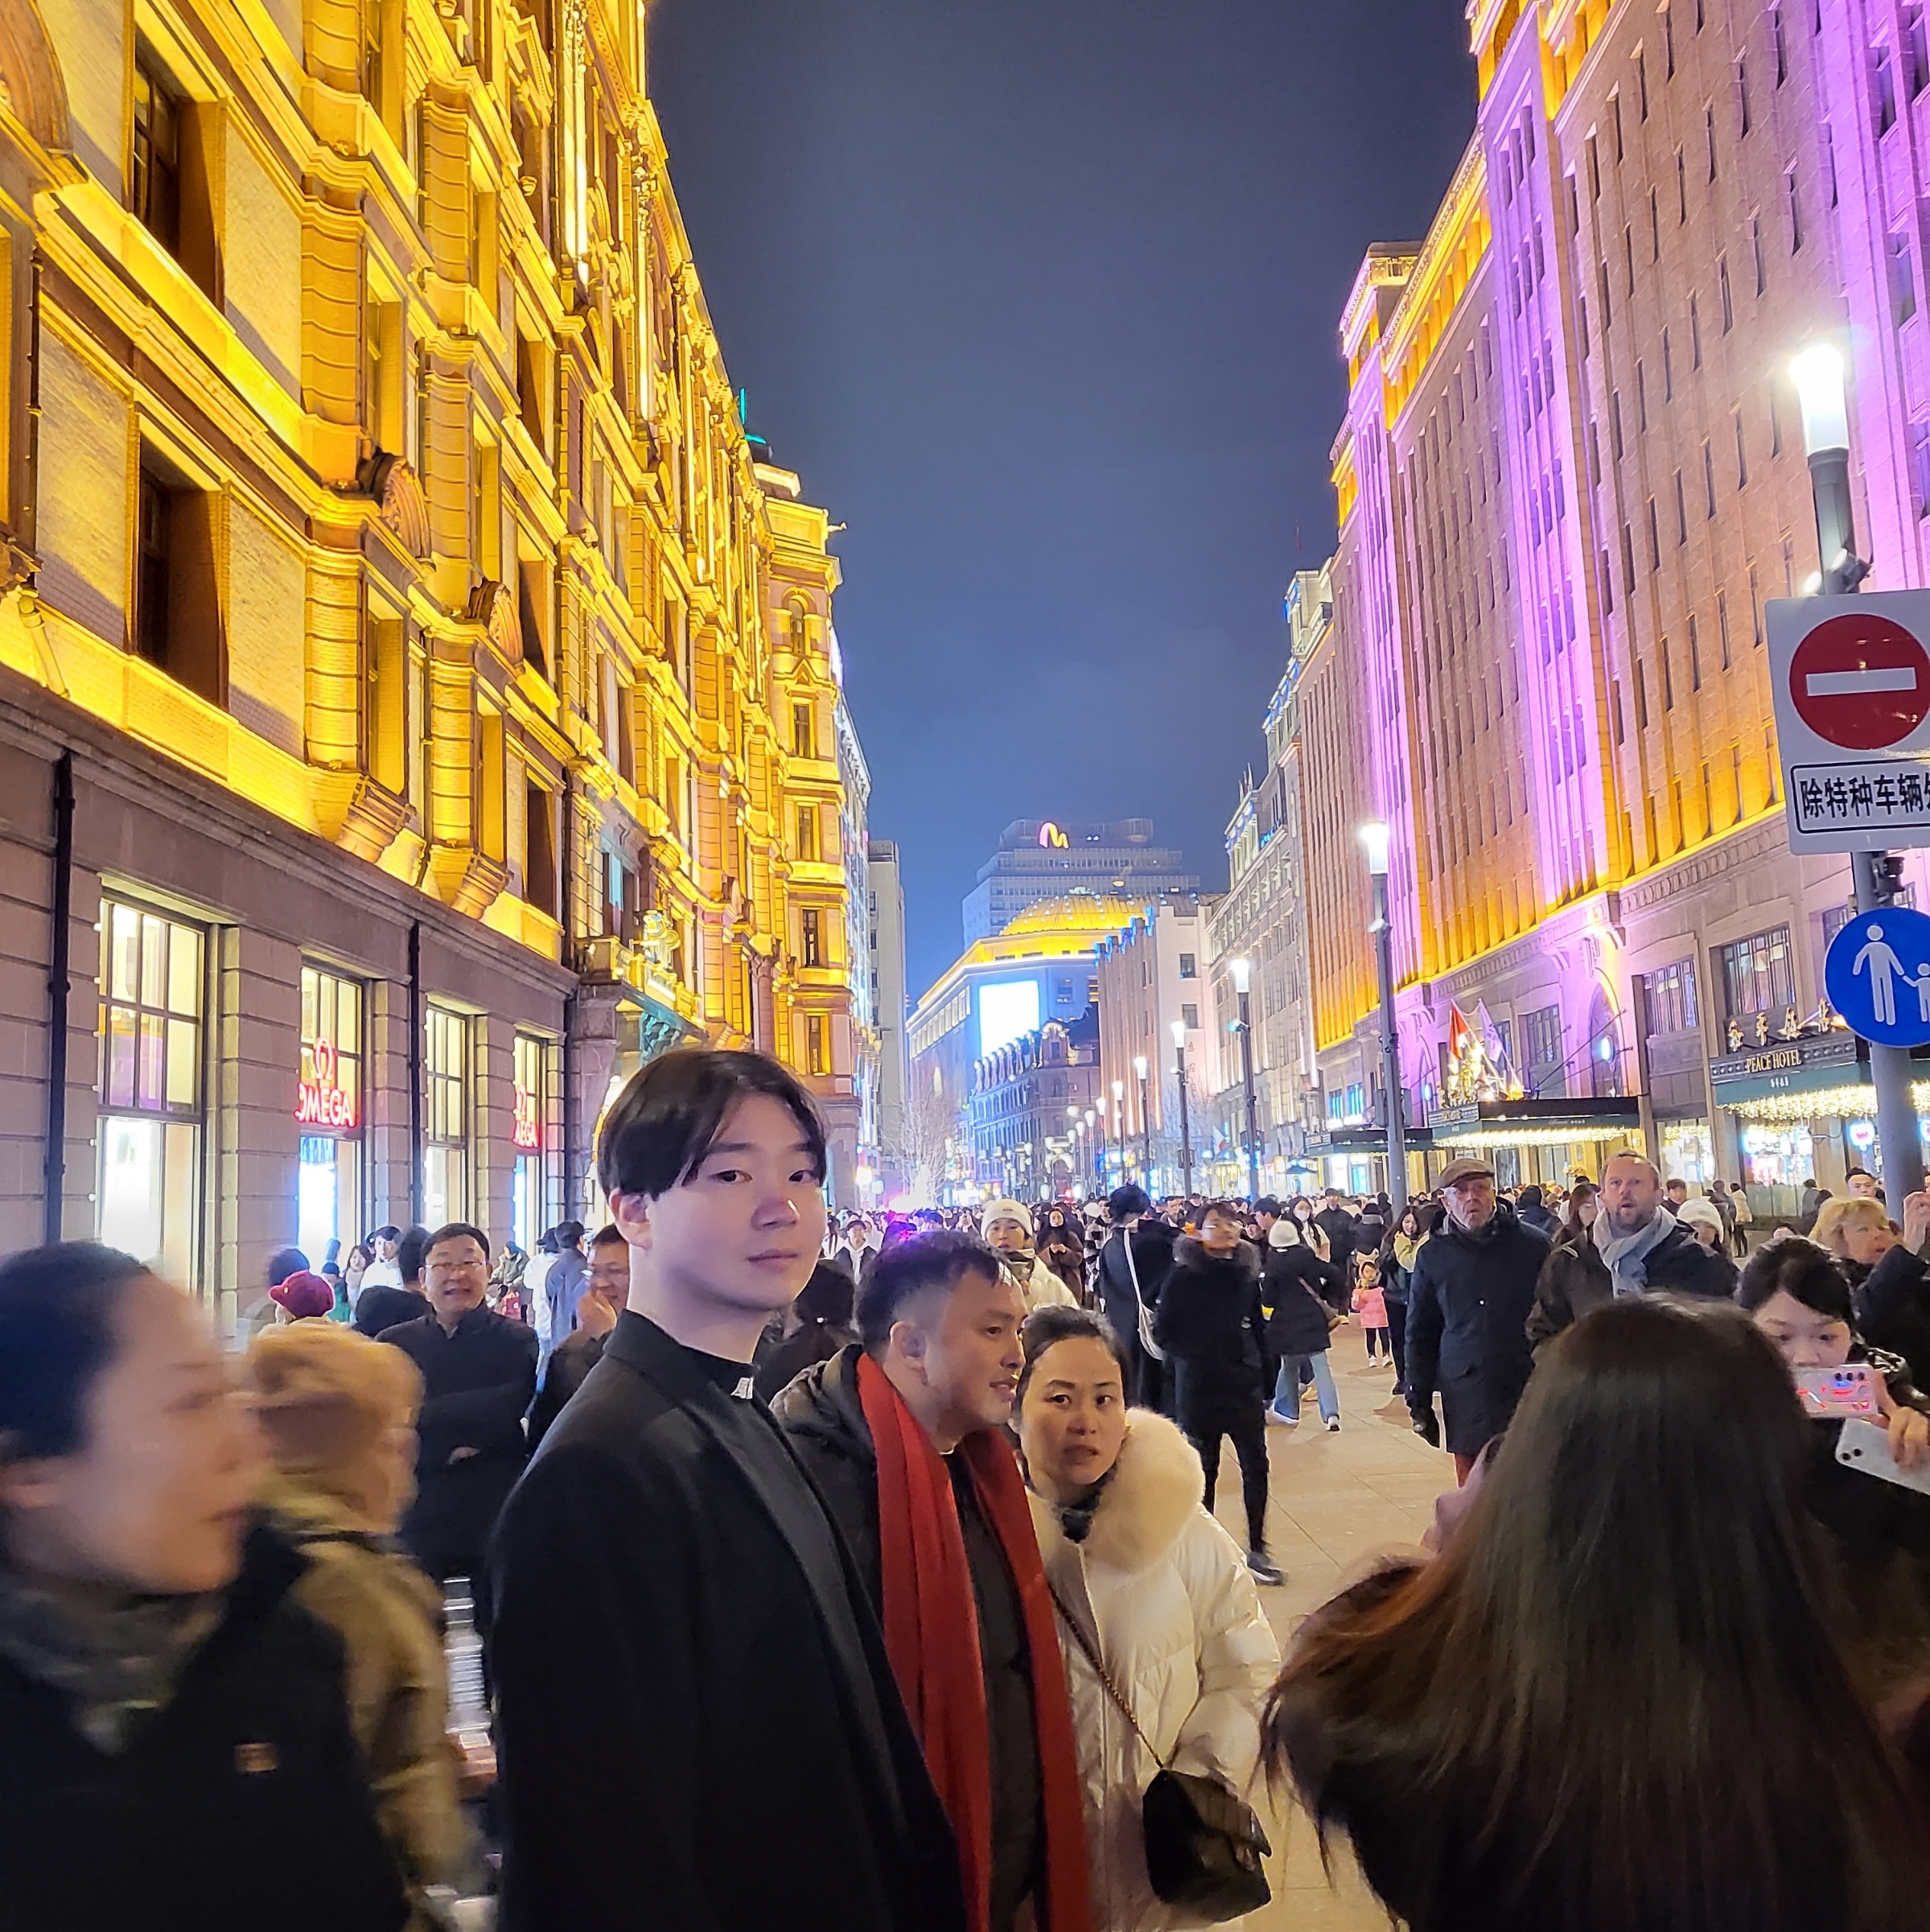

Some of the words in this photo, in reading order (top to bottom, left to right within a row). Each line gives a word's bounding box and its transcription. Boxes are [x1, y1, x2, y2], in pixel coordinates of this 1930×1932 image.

[1799, 772, 1930, 819] 除特种车辆
[1746, 1055, 1772, 1073] PEACE
[1772, 1049, 1802, 1069] HOTEL
